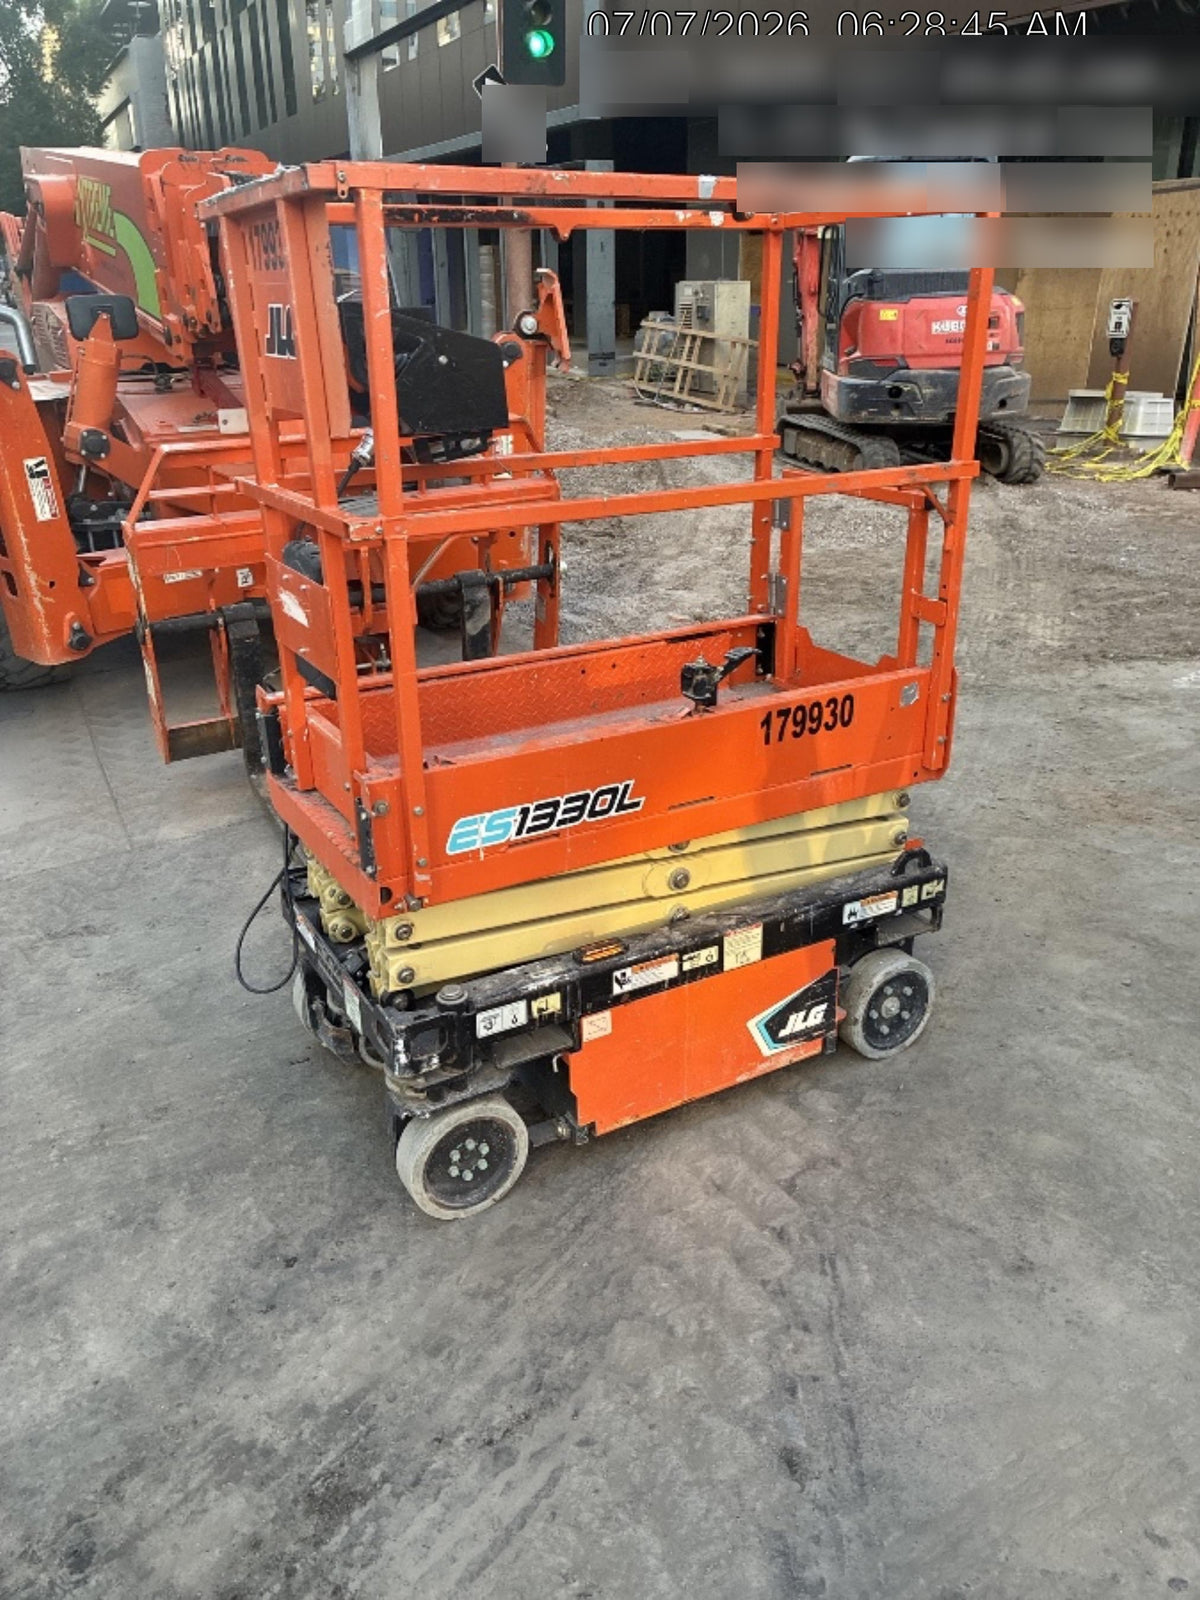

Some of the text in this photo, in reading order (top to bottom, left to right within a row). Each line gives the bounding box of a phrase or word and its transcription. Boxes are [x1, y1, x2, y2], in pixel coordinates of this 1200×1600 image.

[760, 694, 854, 745] 179930
[447, 781, 645, 854] ES1330L
[777, 1002, 829, 1038] JLG
